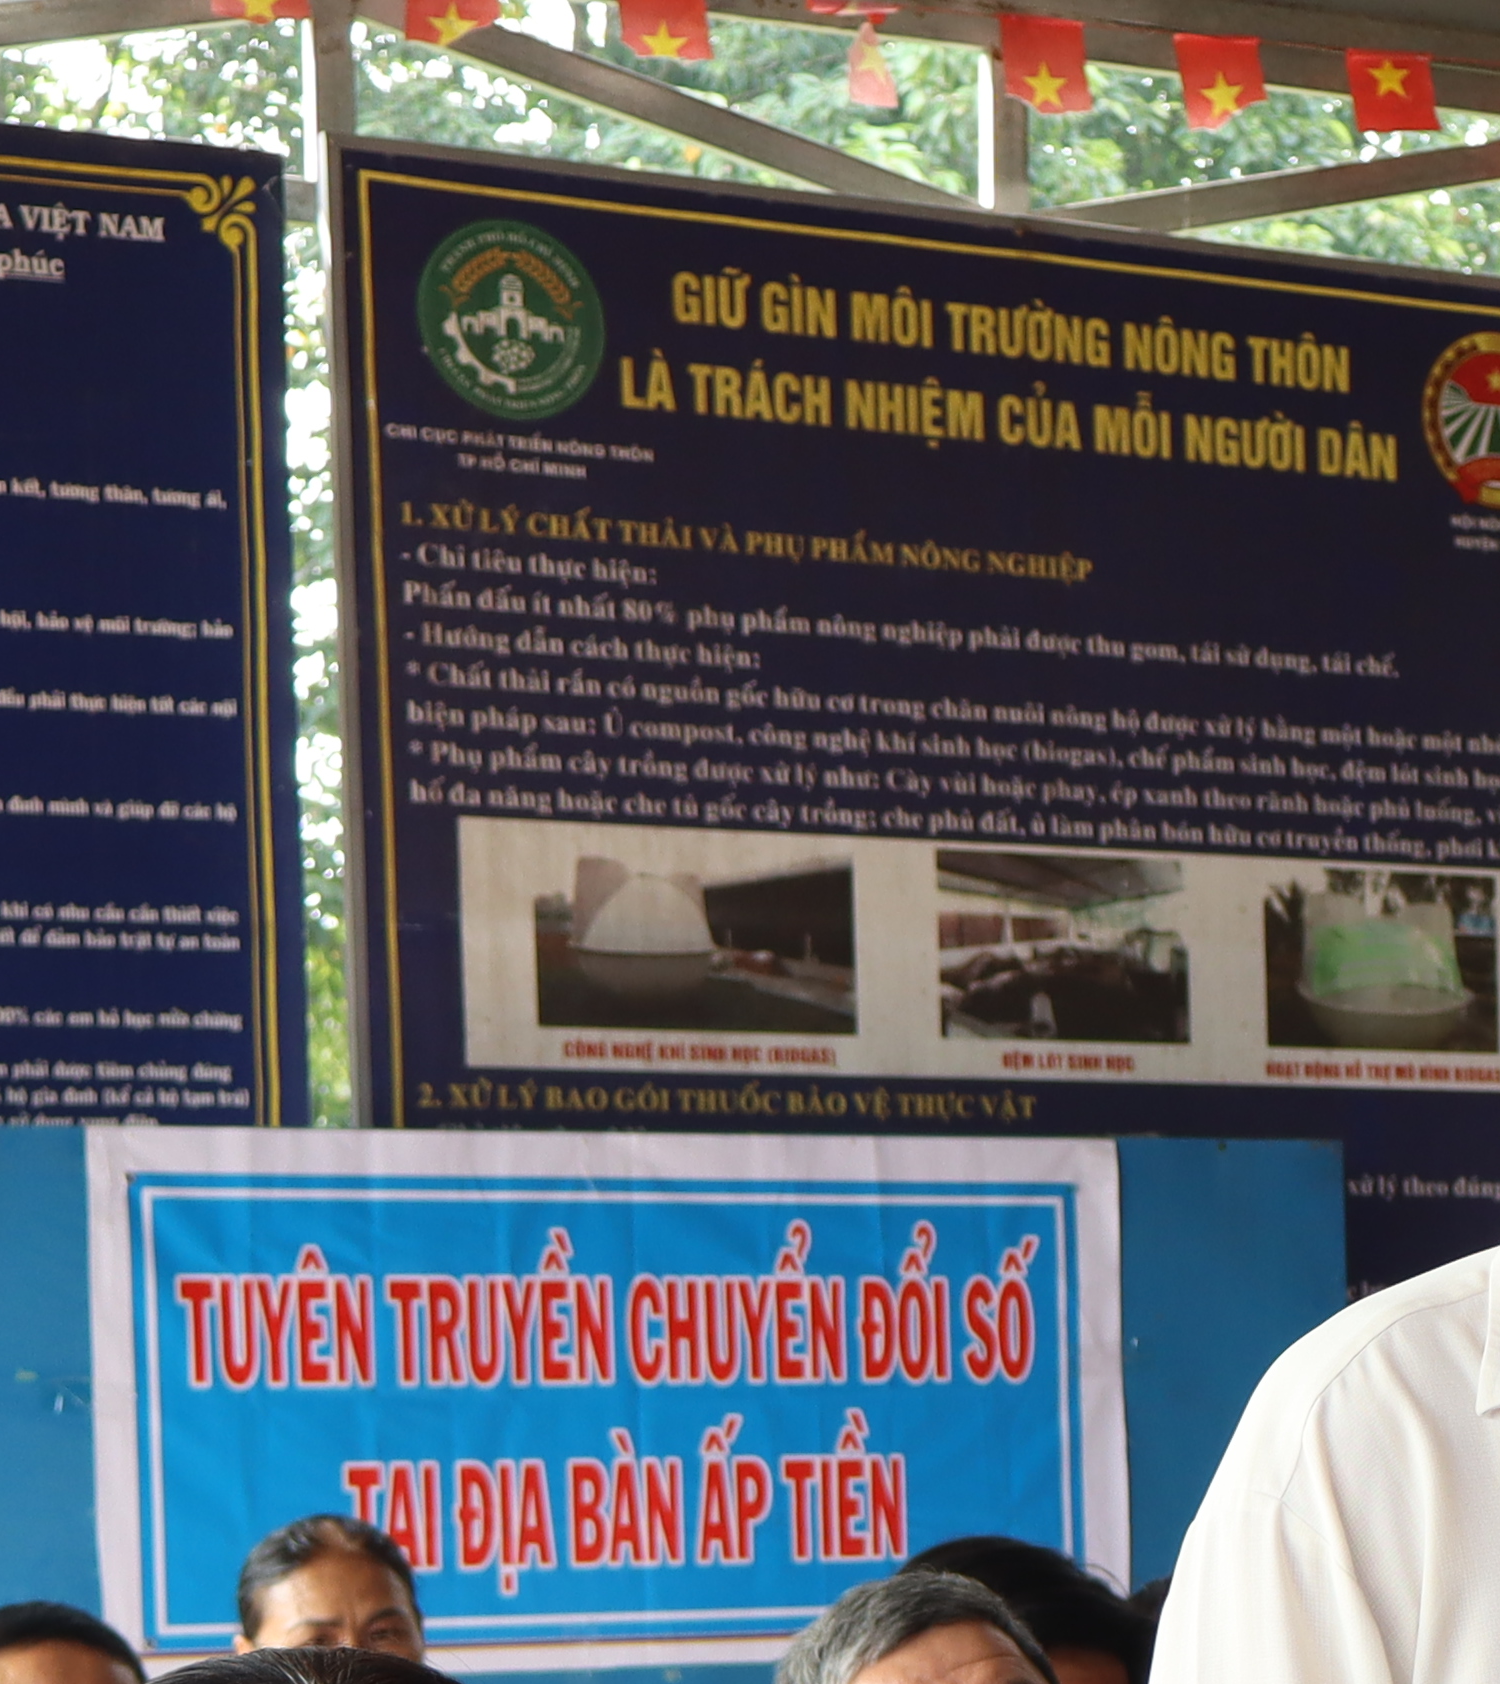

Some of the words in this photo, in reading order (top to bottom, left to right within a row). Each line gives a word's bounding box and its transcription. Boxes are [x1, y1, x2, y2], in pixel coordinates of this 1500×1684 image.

[19, 202, 91, 240] VIỆT
[98, 212, 165, 243] NAM
[672, 266, 753, 329] GIỮ
[760, 274, 839, 339] GÌN
[850, 285, 935, 349] MÔI
[945, 299, 1112, 368] TRƯỜNG
[1123, 315, 1238, 381] NÔNG
[1247, 332, 1352, 393] THÔN
[620, 348, 678, 412] LÀ
[687, 359, 833, 427] TRÁCH
[845, 376, 986, 449] NHIỆM
[997, 381, 1083, 451] CỦA
[1093, 391, 1173, 460] MỖI
[1184, 411, 1308, 473] NGƯỜI
[1317, 420, 1399, 482] DÂN
[430, 499, 472, 530] XỬ
[479, 501, 522, 535] LÝ
[526, 506, 613, 543] CHẤT
[617, 517, 694, 550] THẢI
[699, 523, 741, 554] VÀ
[745, 530, 805, 563] PHỤ
[810, 529, 896, 566] PHẨM
[899, 539, 983, 573] NÔNG
[986, 550, 1095, 585] NGHIỆP
[175, 1245, 375, 1389] TUYÊN
[385, 1228, 615, 1387] TRUYỀN
[626, 1220, 847, 1386] CHUYỂN
[857, 1221, 951, 1383] ĐỔI
[962, 1235, 1039, 1383] SỐ
[454, 1459, 556, 1595] ĐỊA
[567, 1429, 684, 1568] BÀN
[696, 1414, 772, 1564] ẤP
[780, 1409, 910, 1562] TIỀN
